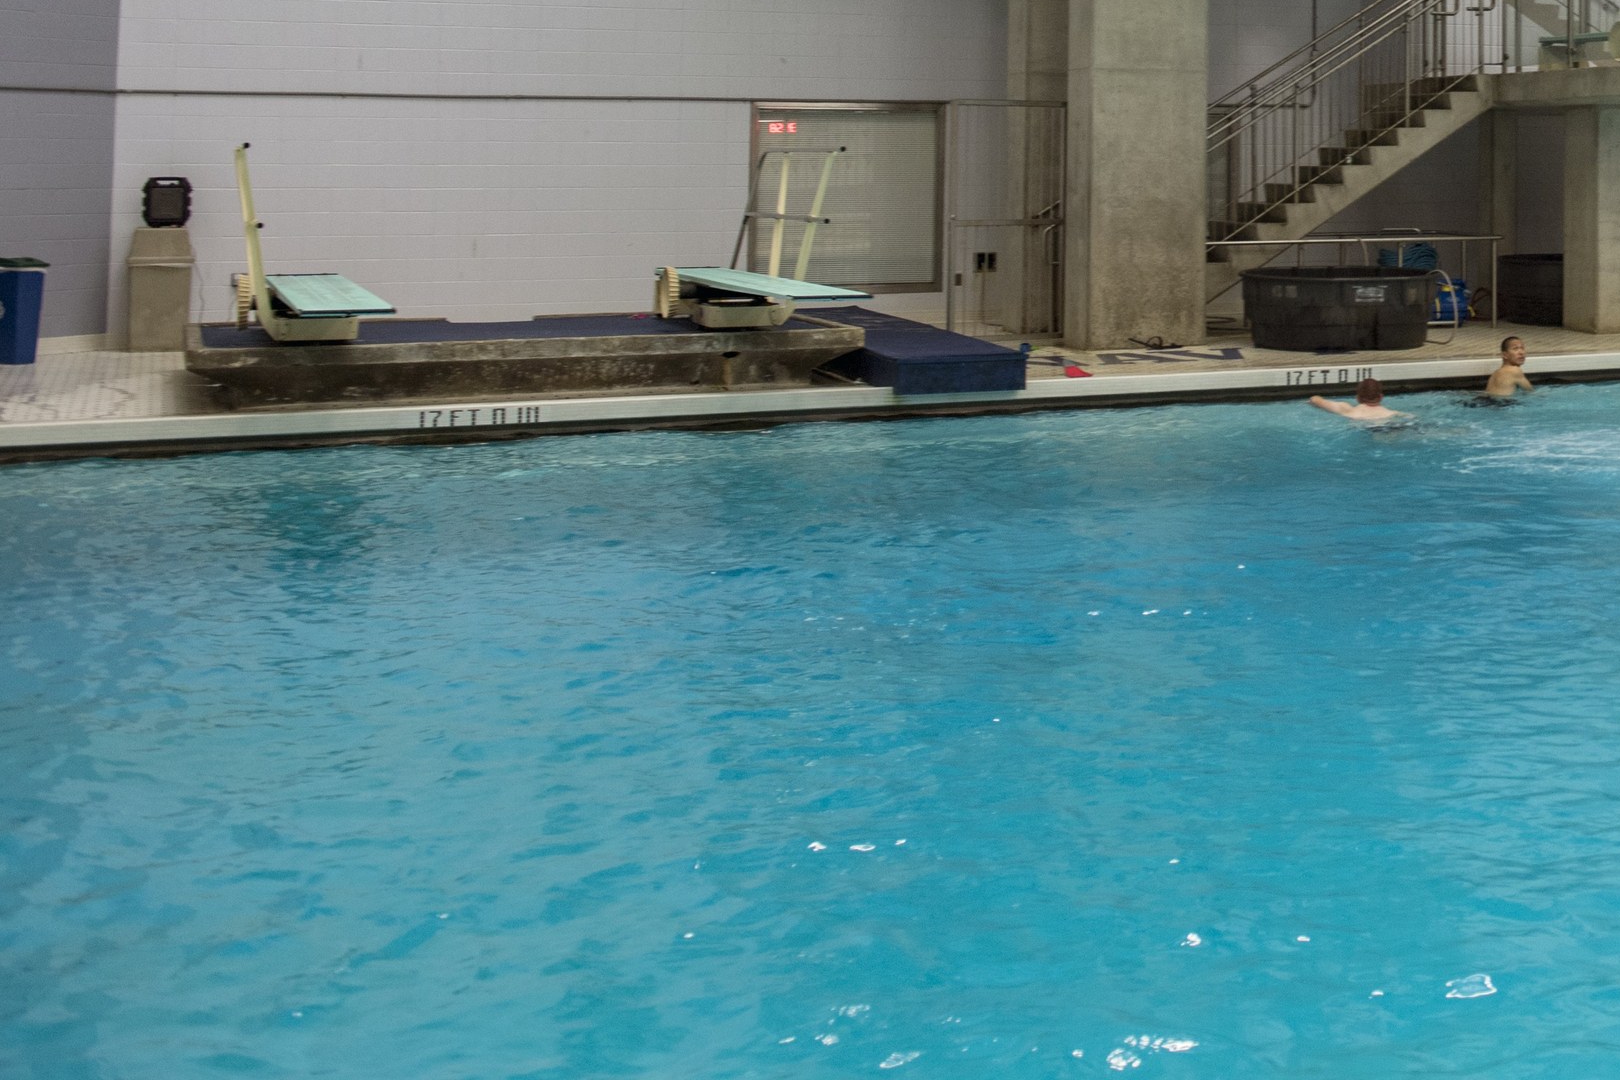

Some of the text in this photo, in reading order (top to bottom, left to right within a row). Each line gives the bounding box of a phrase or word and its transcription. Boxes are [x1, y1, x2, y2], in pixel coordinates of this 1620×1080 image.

[1286, 370, 1303, 385] 17
[1308, 369, 1330, 384] FT
[420, 410, 442, 428] 17
[450, 408, 480, 427] FT
